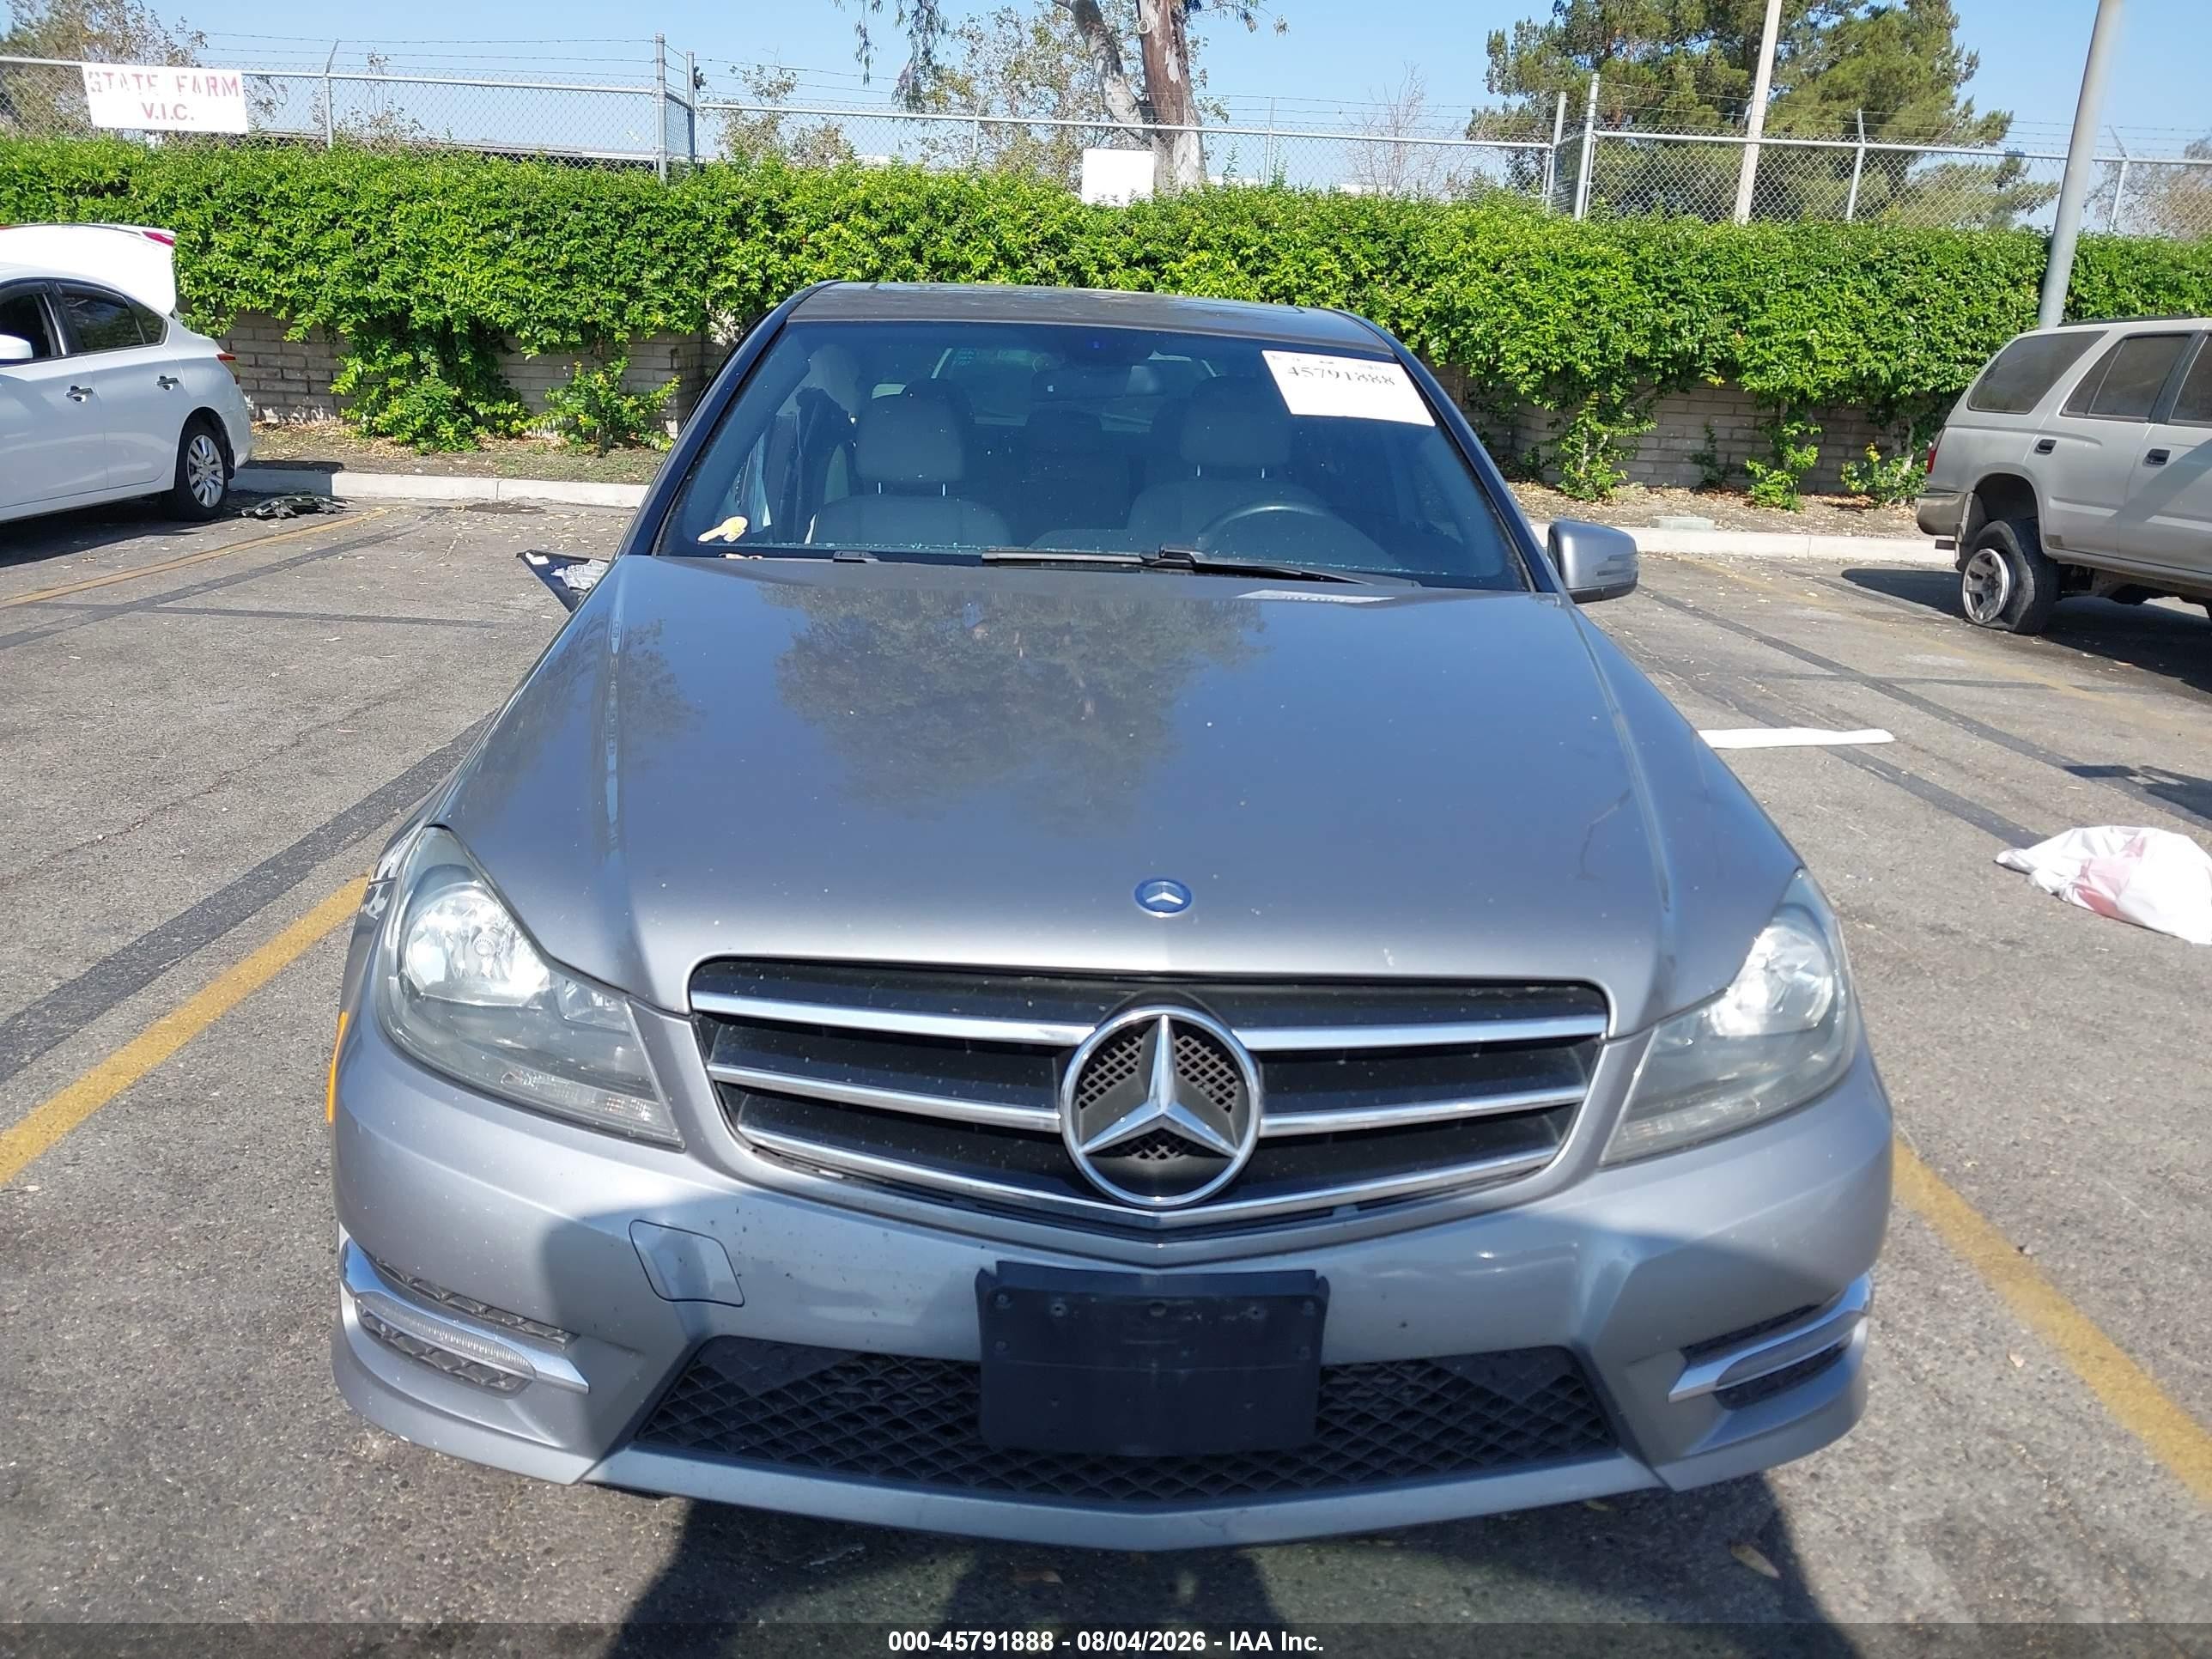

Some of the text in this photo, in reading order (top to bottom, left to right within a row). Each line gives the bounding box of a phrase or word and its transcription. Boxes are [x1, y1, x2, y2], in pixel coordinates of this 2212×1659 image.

[88, 70, 239, 97] STATE FARM
[141, 102, 195, 121] V.I.C.
